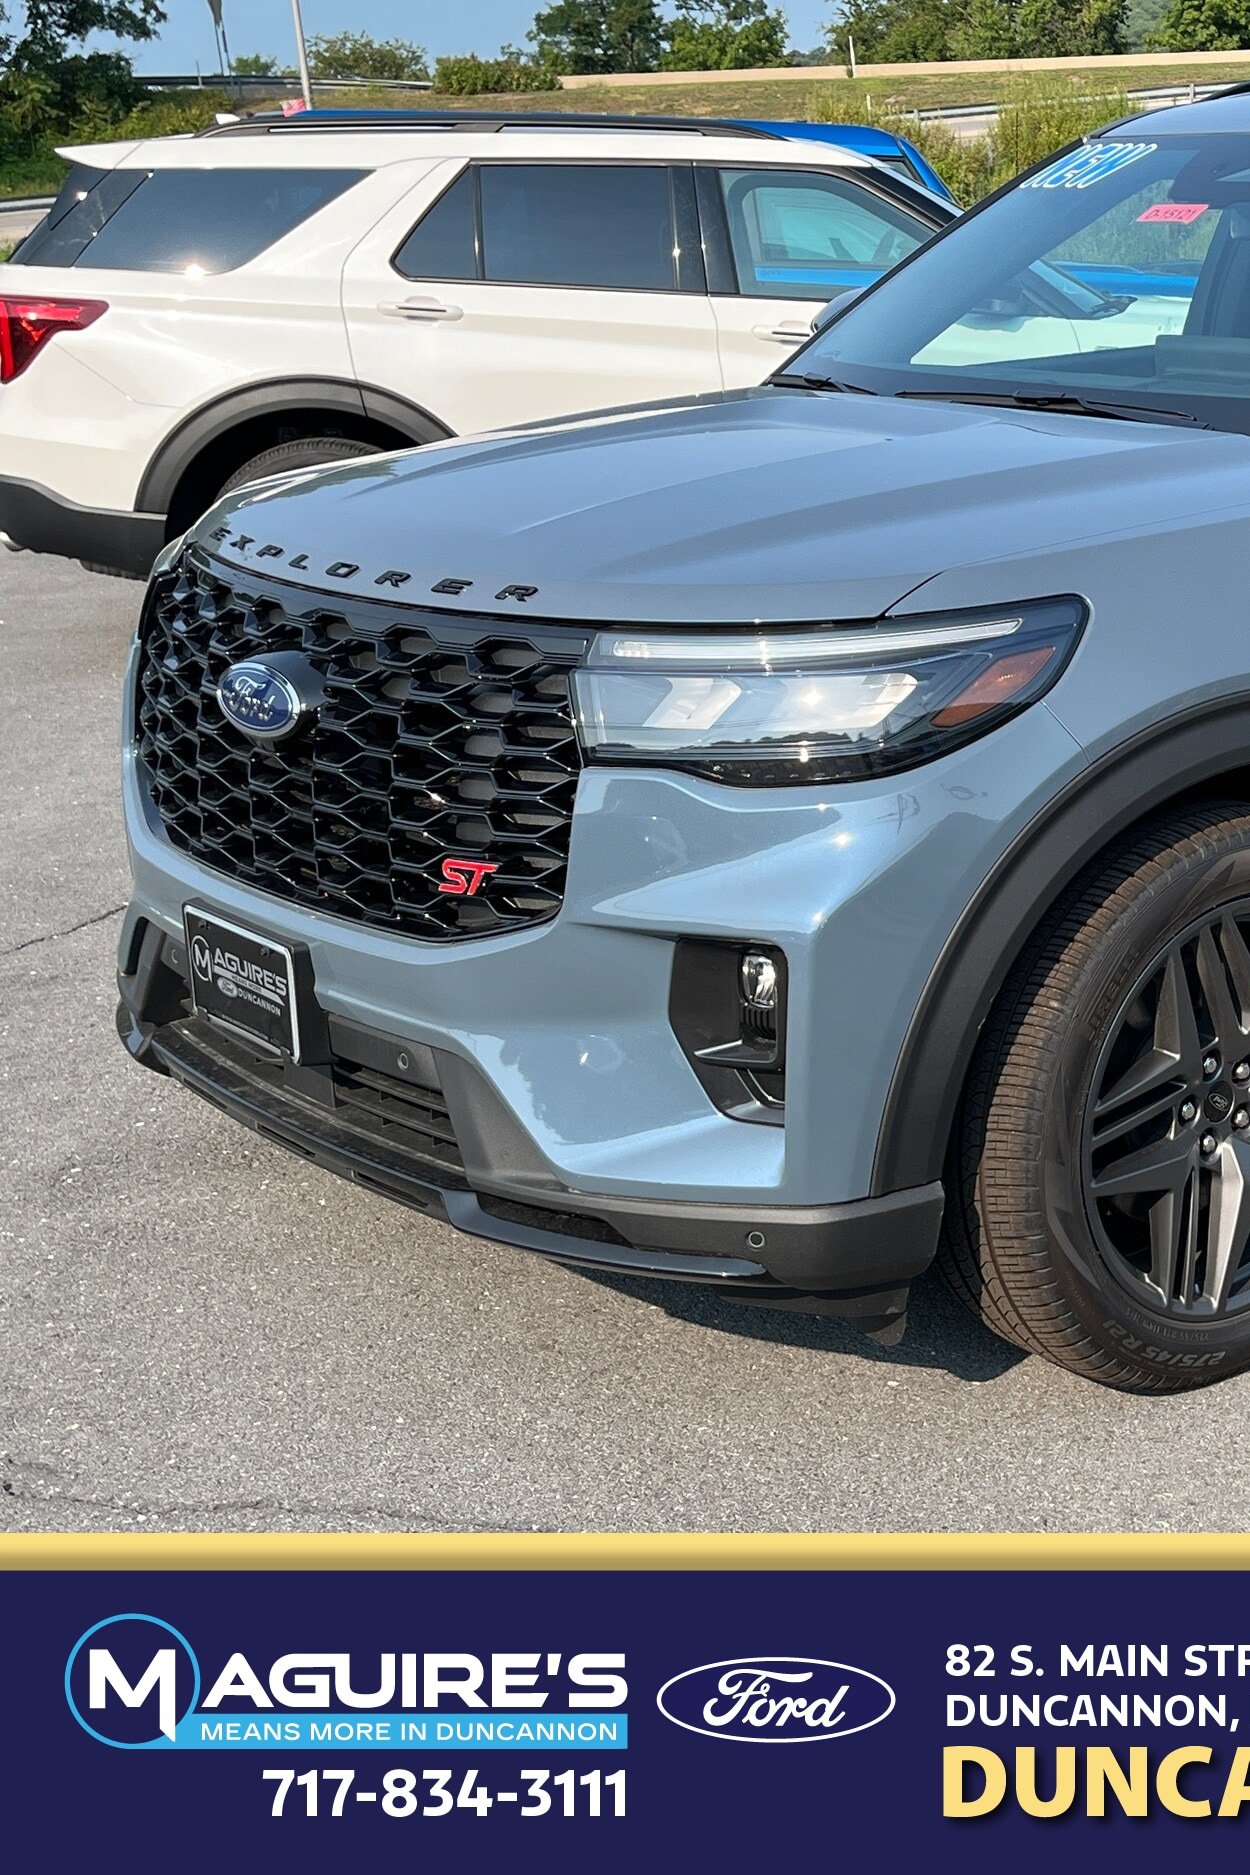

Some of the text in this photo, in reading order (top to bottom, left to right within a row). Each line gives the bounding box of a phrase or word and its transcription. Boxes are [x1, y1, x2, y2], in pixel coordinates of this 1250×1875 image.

[1019, 142, 1158, 189] NEW
[208, 526, 539, 602] EXPLORER
[438, 858, 499, 896] ST
[193, 942, 288, 997] MAGUIRE'S
[238, 987, 281, 1017] DUNCANNON
[1140, 1340, 1227, 1367] 275/45
